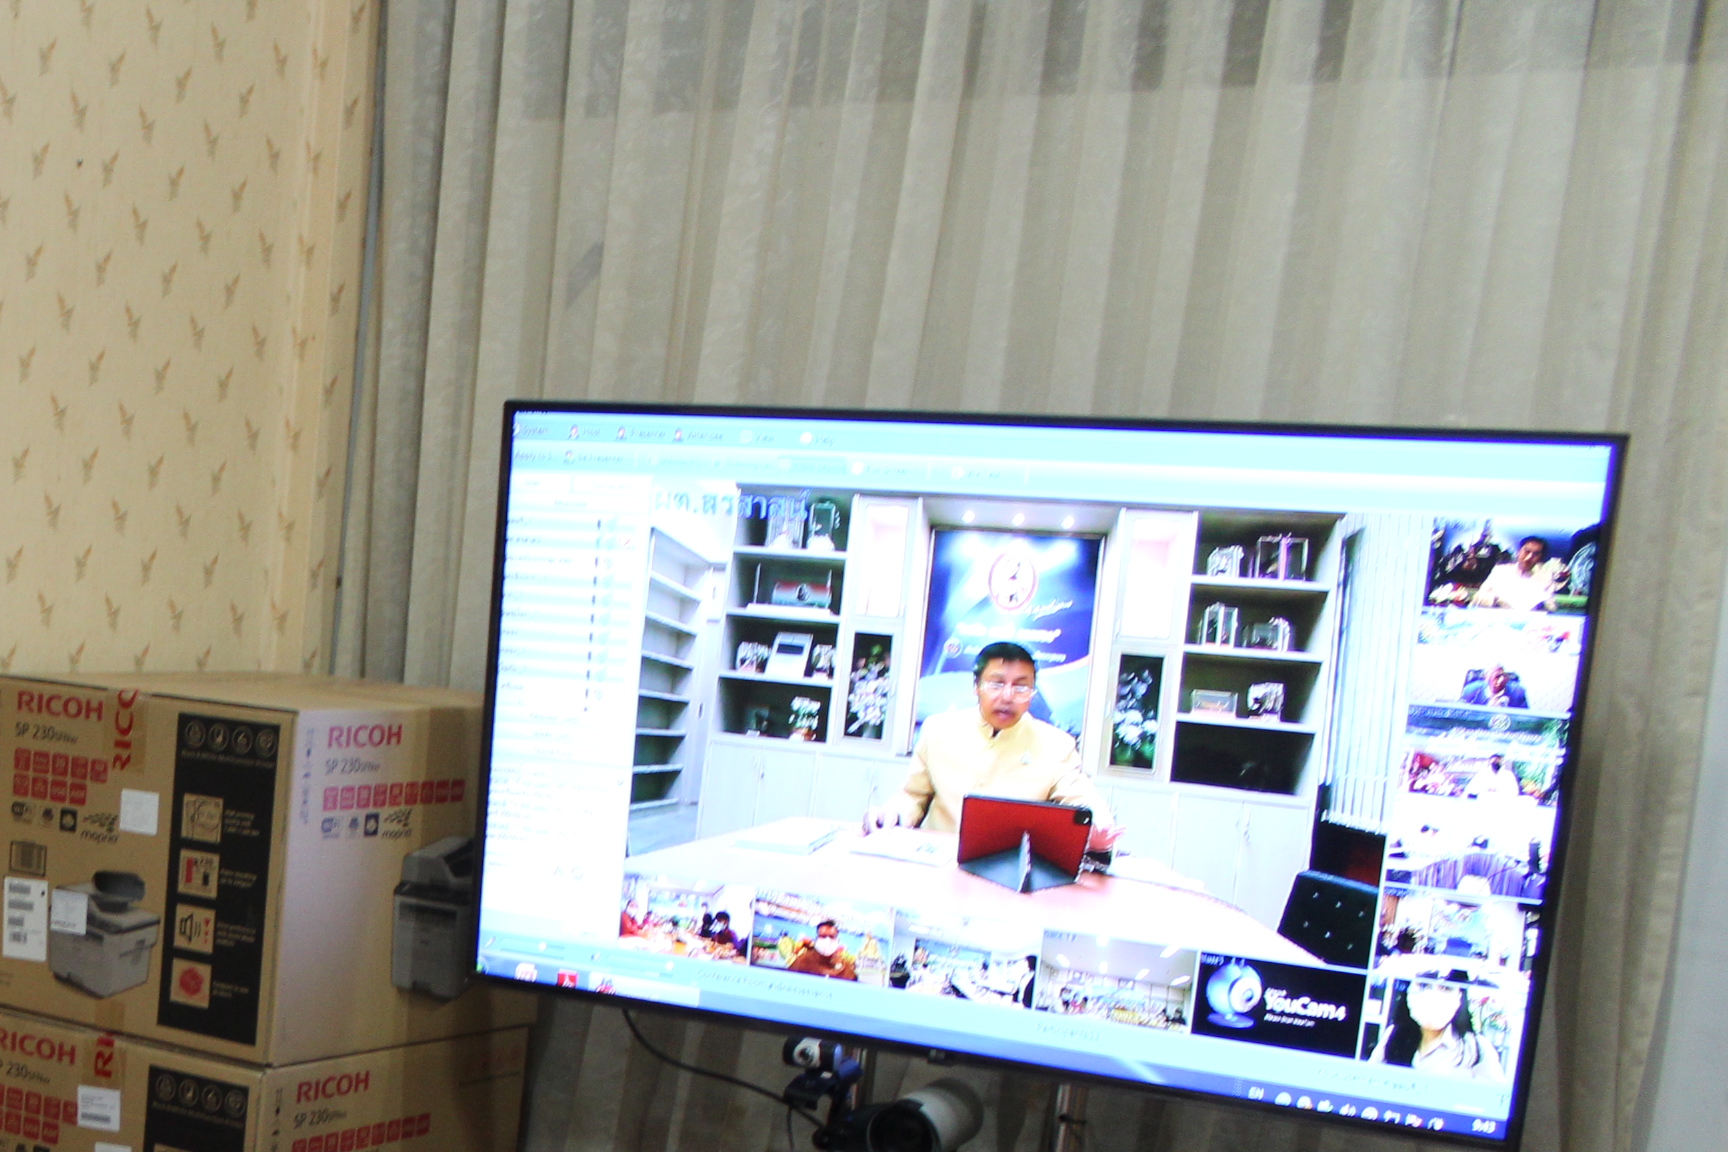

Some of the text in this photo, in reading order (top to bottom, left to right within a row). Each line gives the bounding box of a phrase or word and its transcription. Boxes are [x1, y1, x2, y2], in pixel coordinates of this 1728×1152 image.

[17, 690, 104, 722] RICOH
[328, 723, 403, 748] RICOH
[296, 1070, 370, 1104] RICOH
